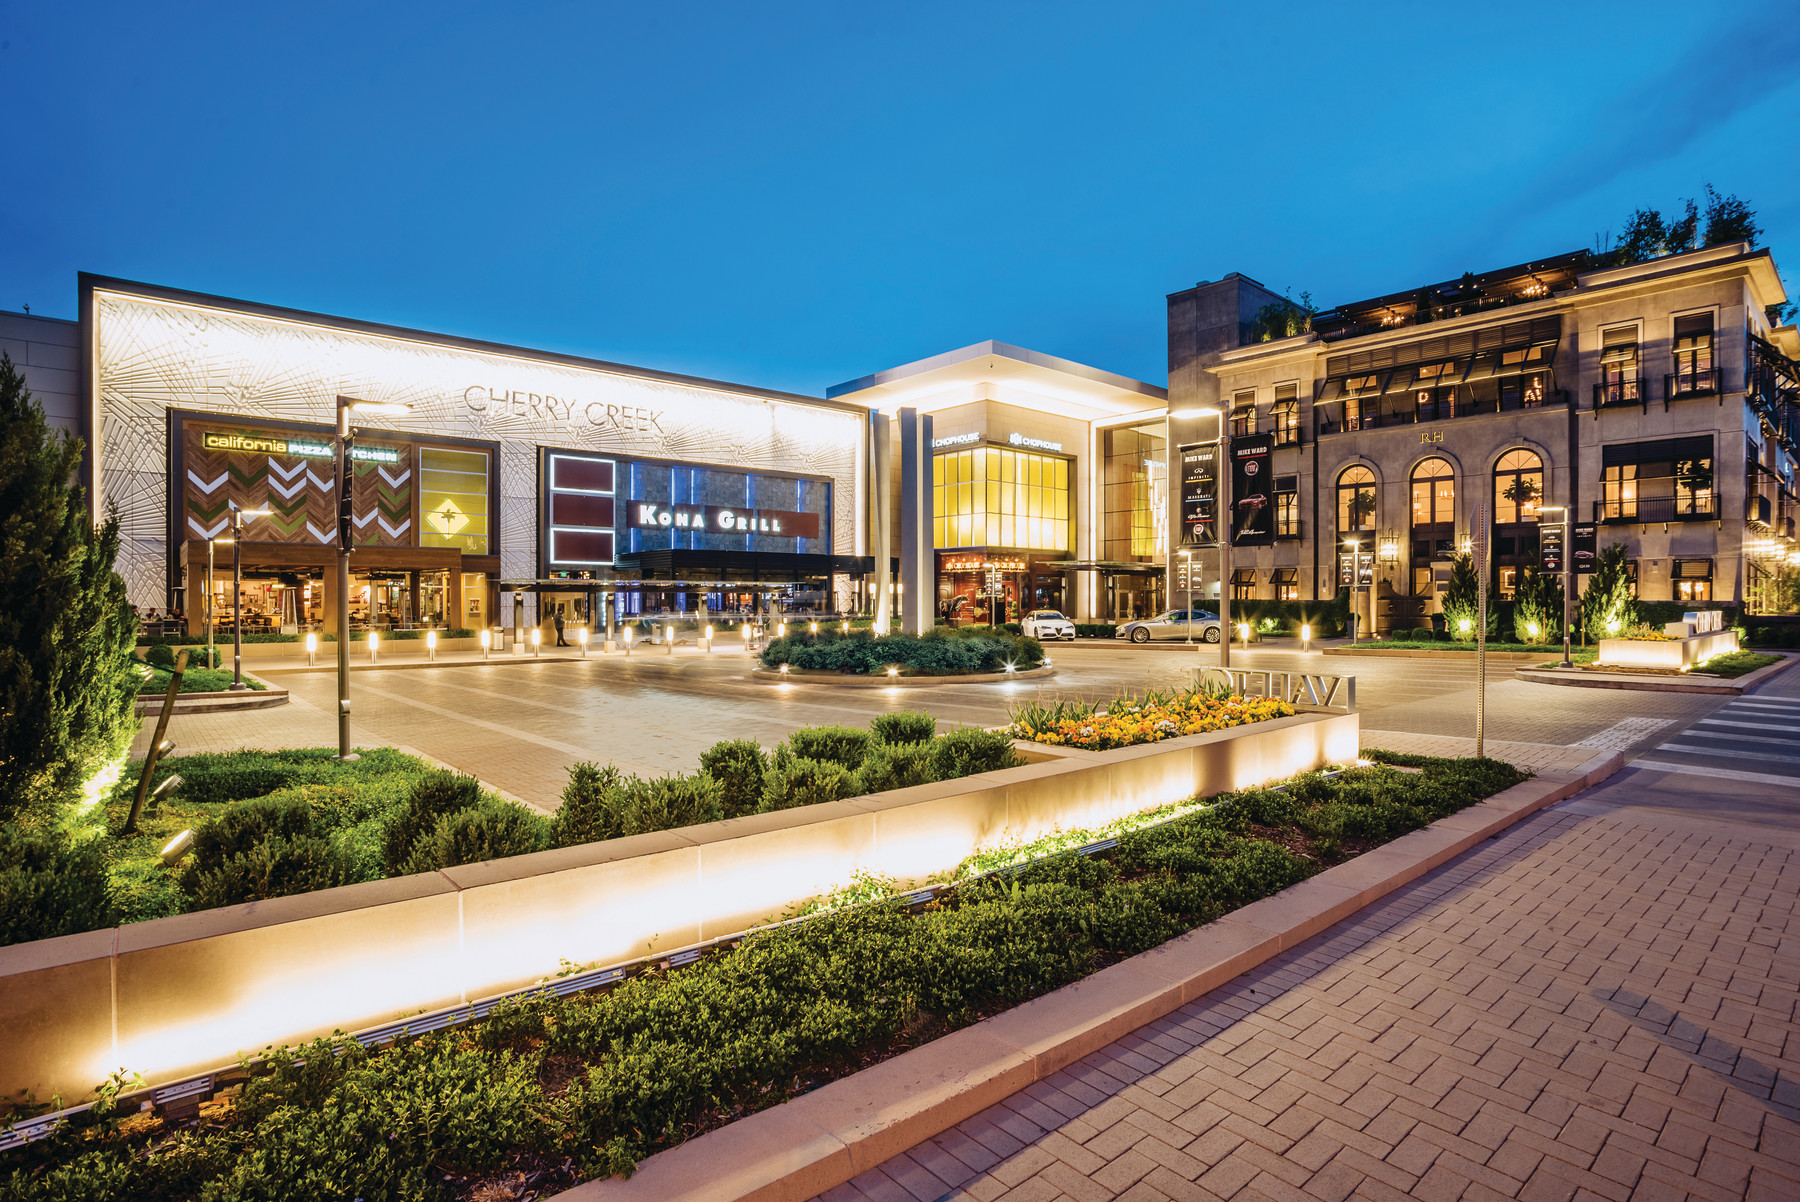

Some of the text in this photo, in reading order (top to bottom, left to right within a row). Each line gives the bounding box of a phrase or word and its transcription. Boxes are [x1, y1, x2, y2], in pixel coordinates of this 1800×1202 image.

[464, 385, 664, 434] CHERRY CREEK
[935, 432, 980, 447] CHOPHOUSE
[1022, 437, 1063, 452] CHOPHOUSE
[1420, 431, 1444, 444] RH
[208, 435, 398, 462] california PIZZA TCHEN
[1251, 446, 1267, 454] WARD
[639, 504, 781, 533] KONA GRILL
